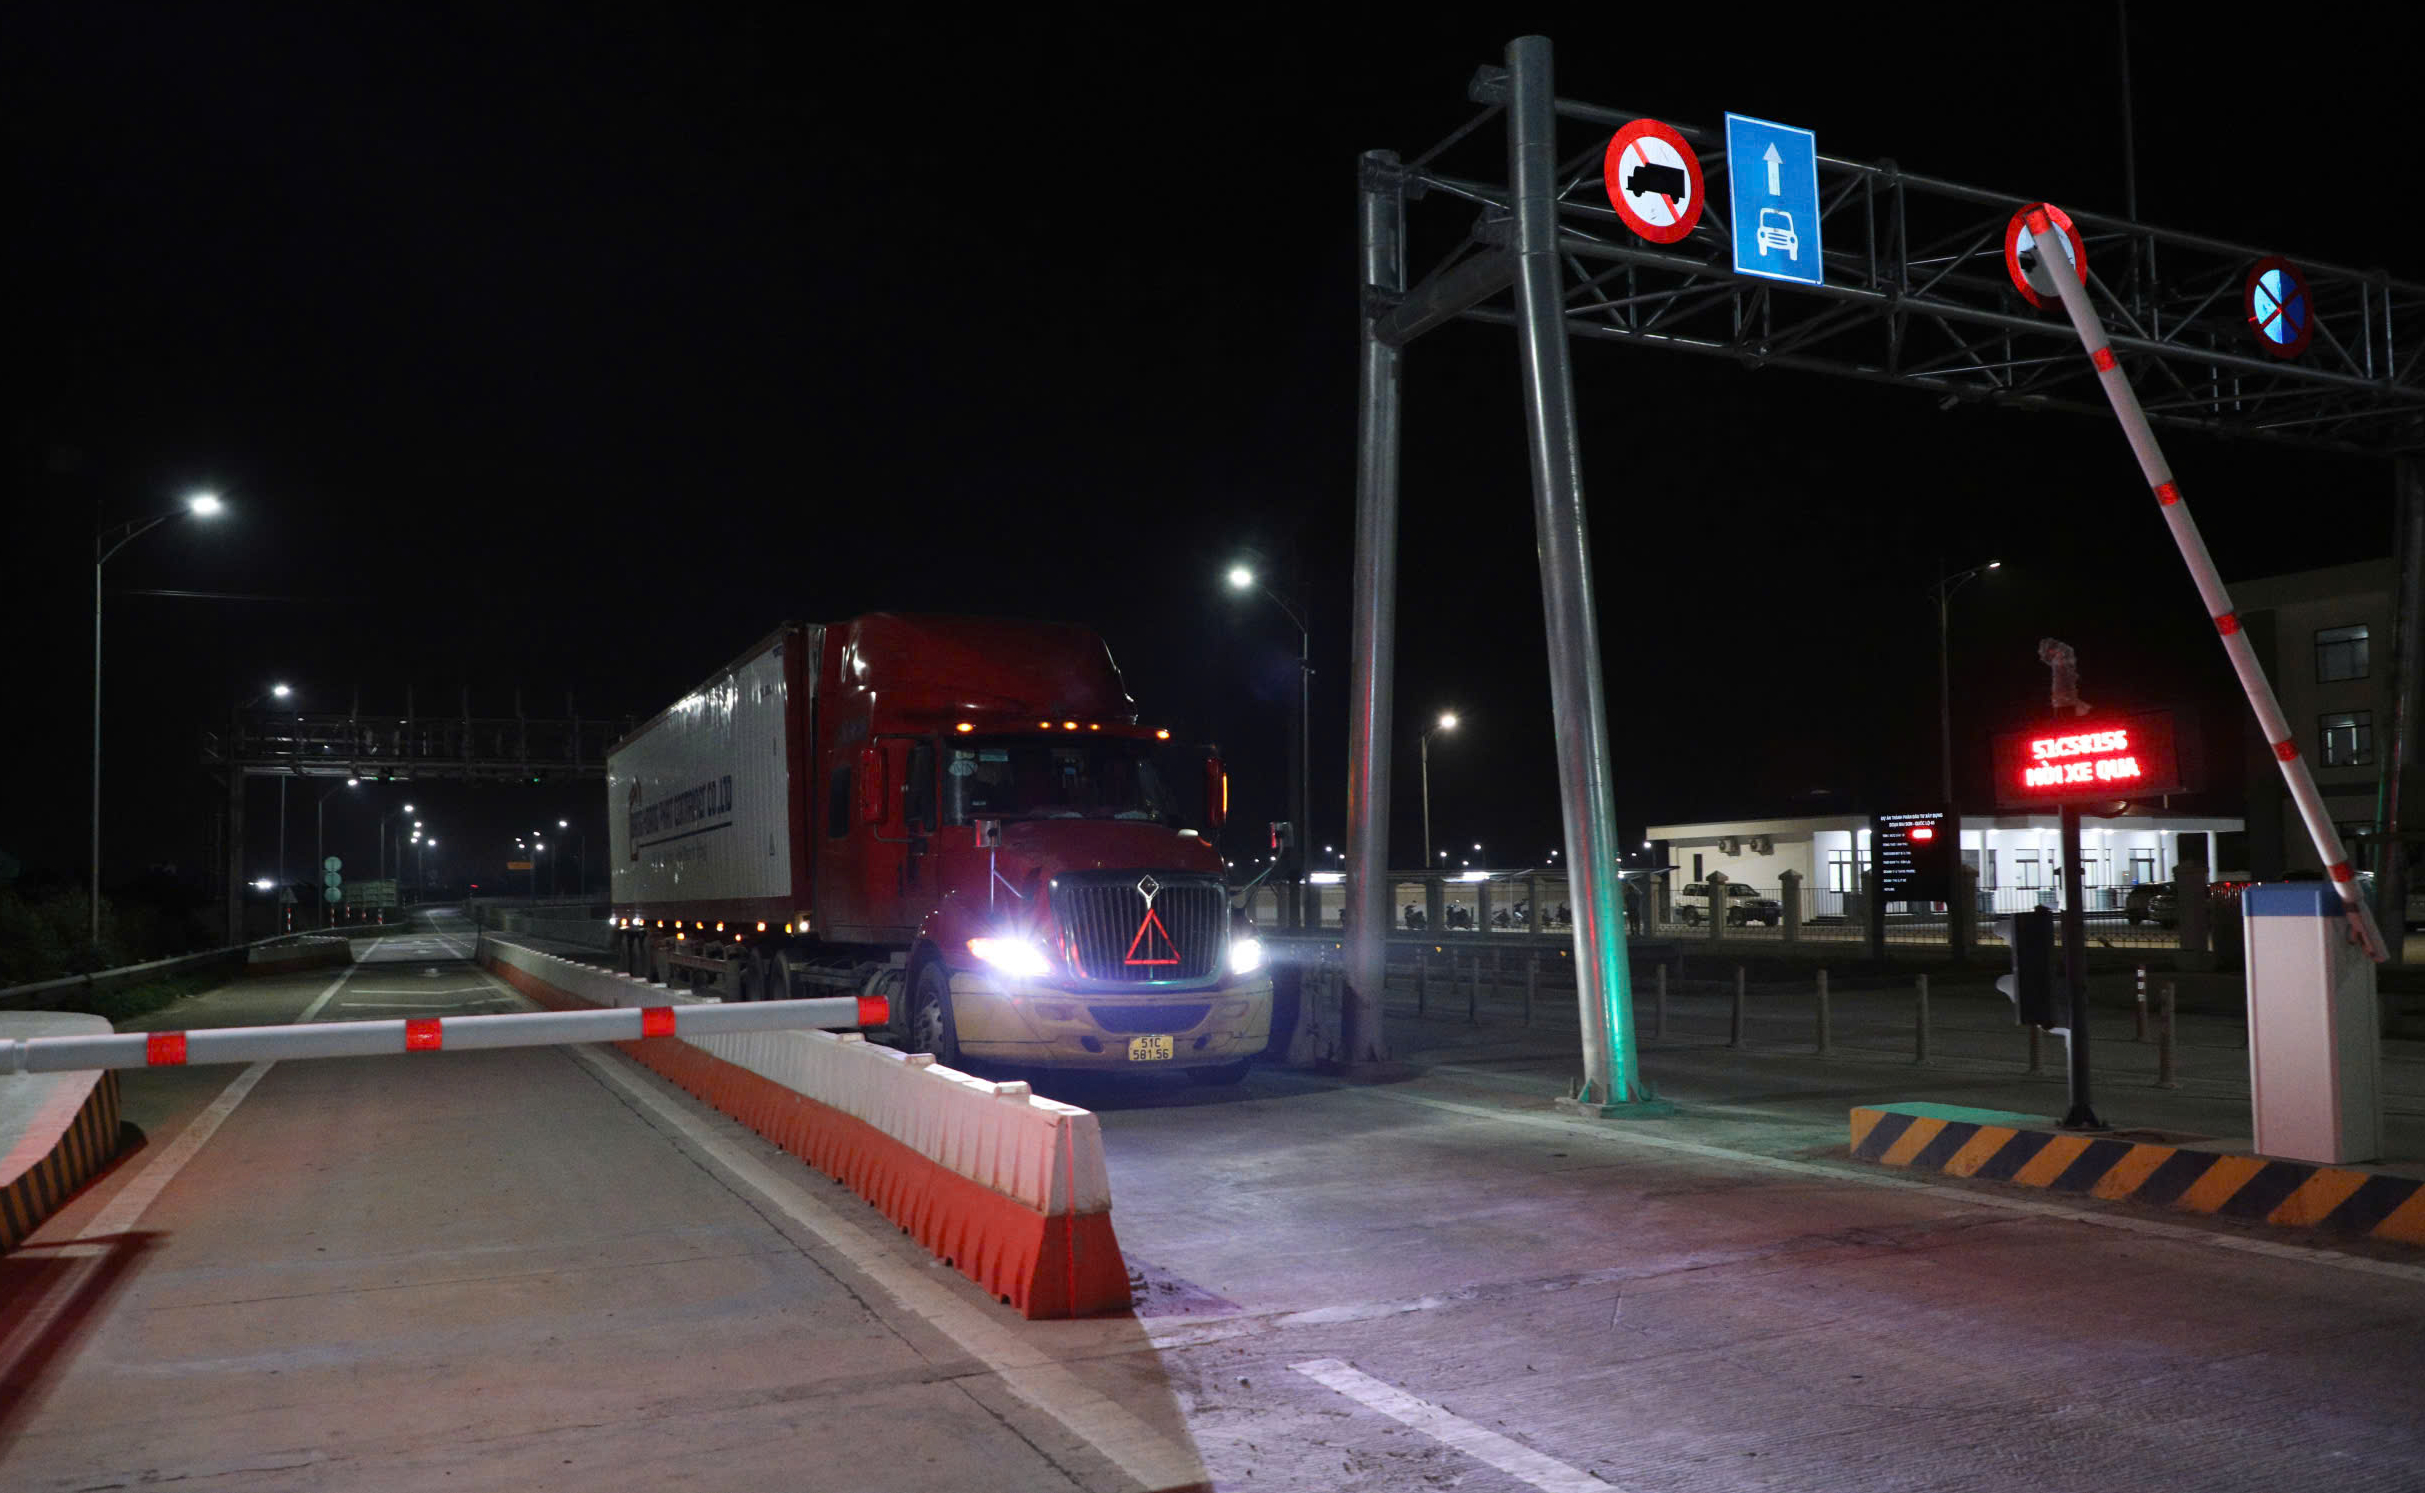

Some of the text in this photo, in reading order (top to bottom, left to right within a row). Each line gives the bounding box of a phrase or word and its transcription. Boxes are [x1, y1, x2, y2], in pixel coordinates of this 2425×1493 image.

[2065, 762, 2093, 782] XE
[2096, 757, 2140, 781] QUA
[1141, 1037, 1161, 1048] 51C
